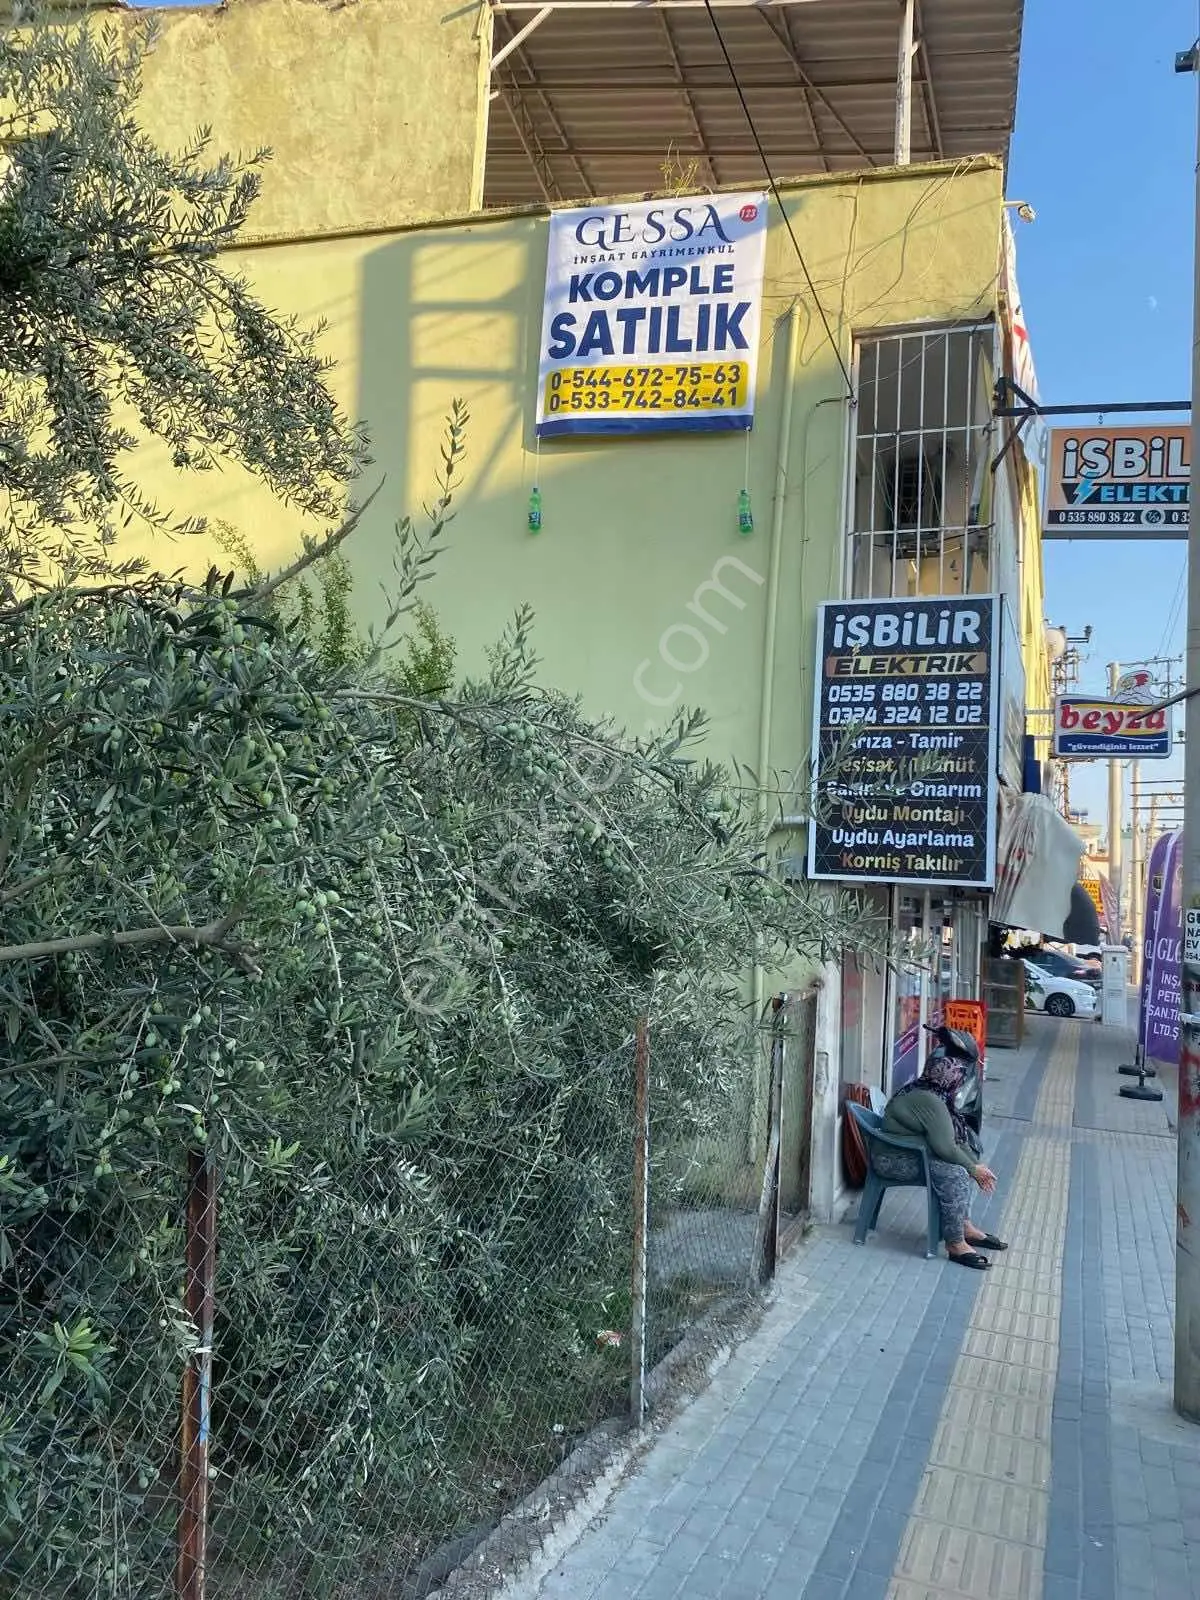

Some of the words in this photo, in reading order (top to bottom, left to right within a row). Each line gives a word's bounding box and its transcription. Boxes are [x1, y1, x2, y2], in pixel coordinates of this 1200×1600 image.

[575, 203, 736, 251] GESSA
[573, 252, 626, 265] İNŞAAT
[631, 245, 735, 260] GAYRİMENKUL
[568, 263, 735, 304] KOMPLE
[547, 302, 752, 359] SATILIK
[551, 365, 741, 391] 0-544-672-75-63
[549, 388, 738, 412] 0-533-742-84-41
[1101, 485, 1190, 502] ELEKT
[1068, 511, 1085, 522] 535
[1088, 511, 1106, 523] 880
[1108, 511, 1120, 523] 38
[1123, 511, 1135, 523] 22
[828, 684, 876, 702] 0535
[882, 684, 919, 701] 880
[924, 683, 950, 701] 38
[956, 682, 983, 700] 22
[828, 707, 877, 724] 0324
[883, 706, 922, 724] 324
[929, 705, 949, 723] 12
[955, 705, 983, 723] 02
[1060, 704, 1166, 735] beyza
[909, 733, 964, 749] Tamir
[910, 781, 982, 798] Onarım
[893, 806, 965, 826] Montajı
[832, 829, 879, 848] Uydu
[882, 830, 974, 849] Ayarlama
[842, 853, 901, 871] Korniş
[905, 854, 963, 871] Takılır
